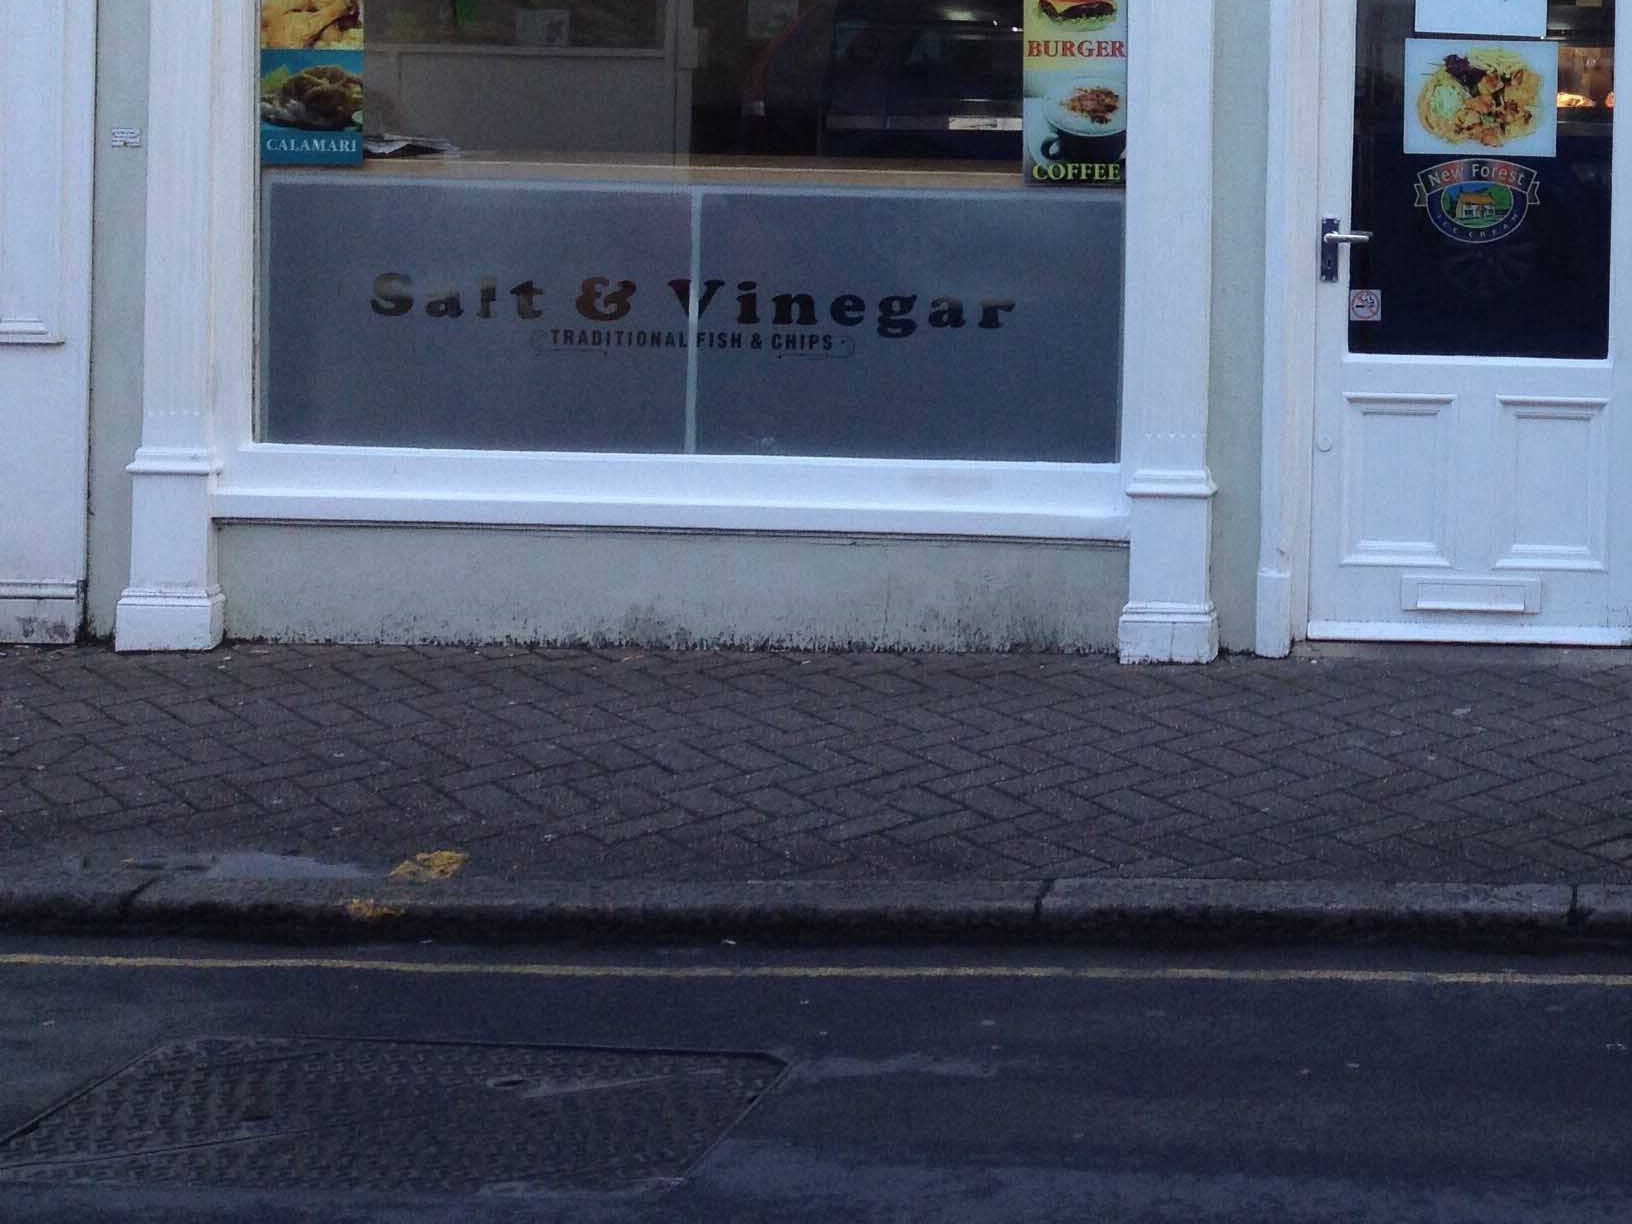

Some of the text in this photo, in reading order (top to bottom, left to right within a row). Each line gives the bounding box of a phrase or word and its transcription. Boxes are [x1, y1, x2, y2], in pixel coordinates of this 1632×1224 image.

[1027, 39, 1126, 58] BURGER
[266, 137, 357, 153] CALAMARI
[1032, 163, 1121, 182] COFFEE
[1428, 163, 1525, 186] New Forest
[370, 272, 1017, 340] Salt & Vinegar
[550, 329, 690, 351] TRADITIONAL
[695, 331, 746, 351] FISH
[771, 333, 834, 352] CHIPS
